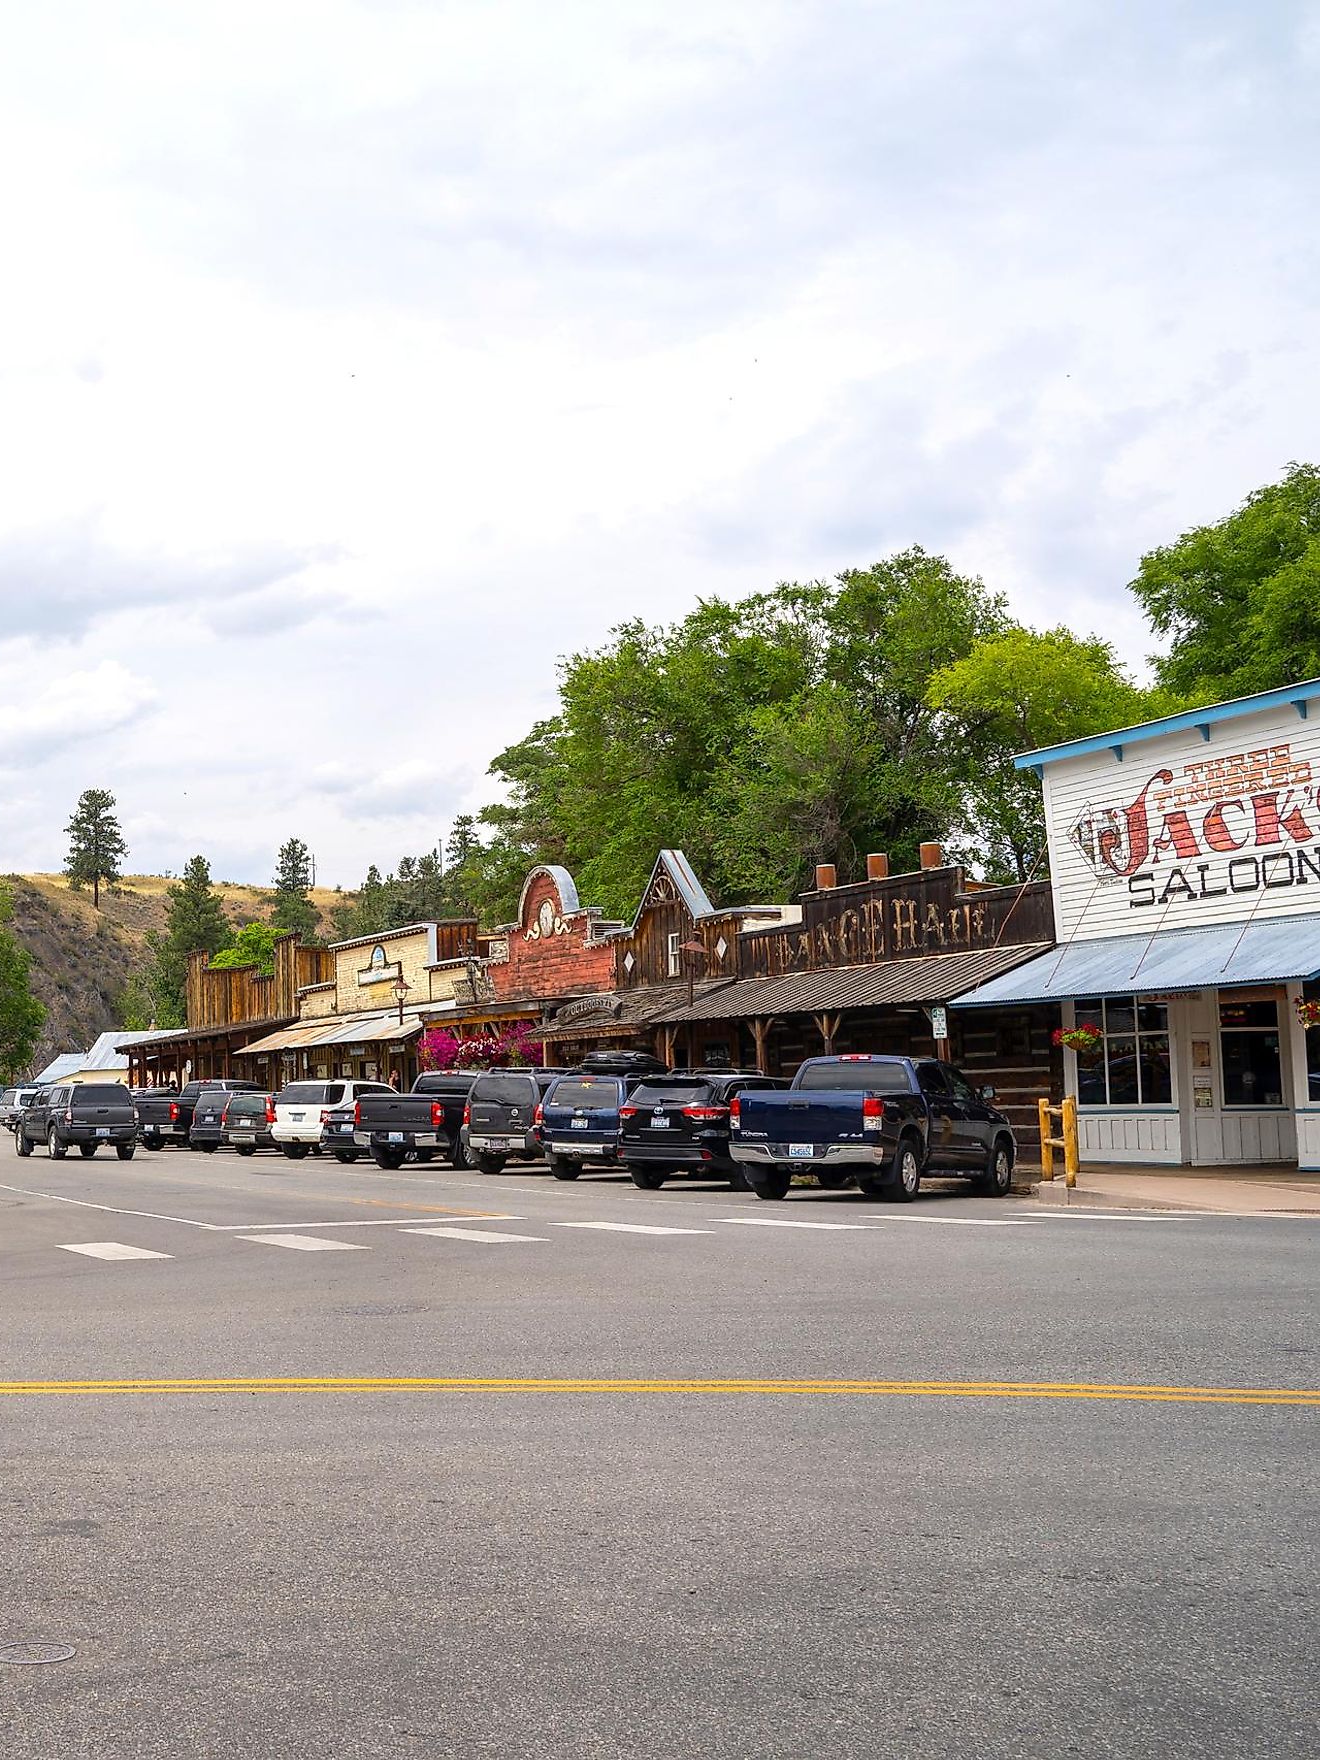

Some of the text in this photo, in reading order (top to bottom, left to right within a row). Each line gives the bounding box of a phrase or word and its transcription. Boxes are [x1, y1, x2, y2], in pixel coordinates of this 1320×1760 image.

[1152, 744, 1313, 812] THREE FINGERED
[1098, 768, 1320, 876] JACK'
[1128, 849, 1320, 909] SALOON
